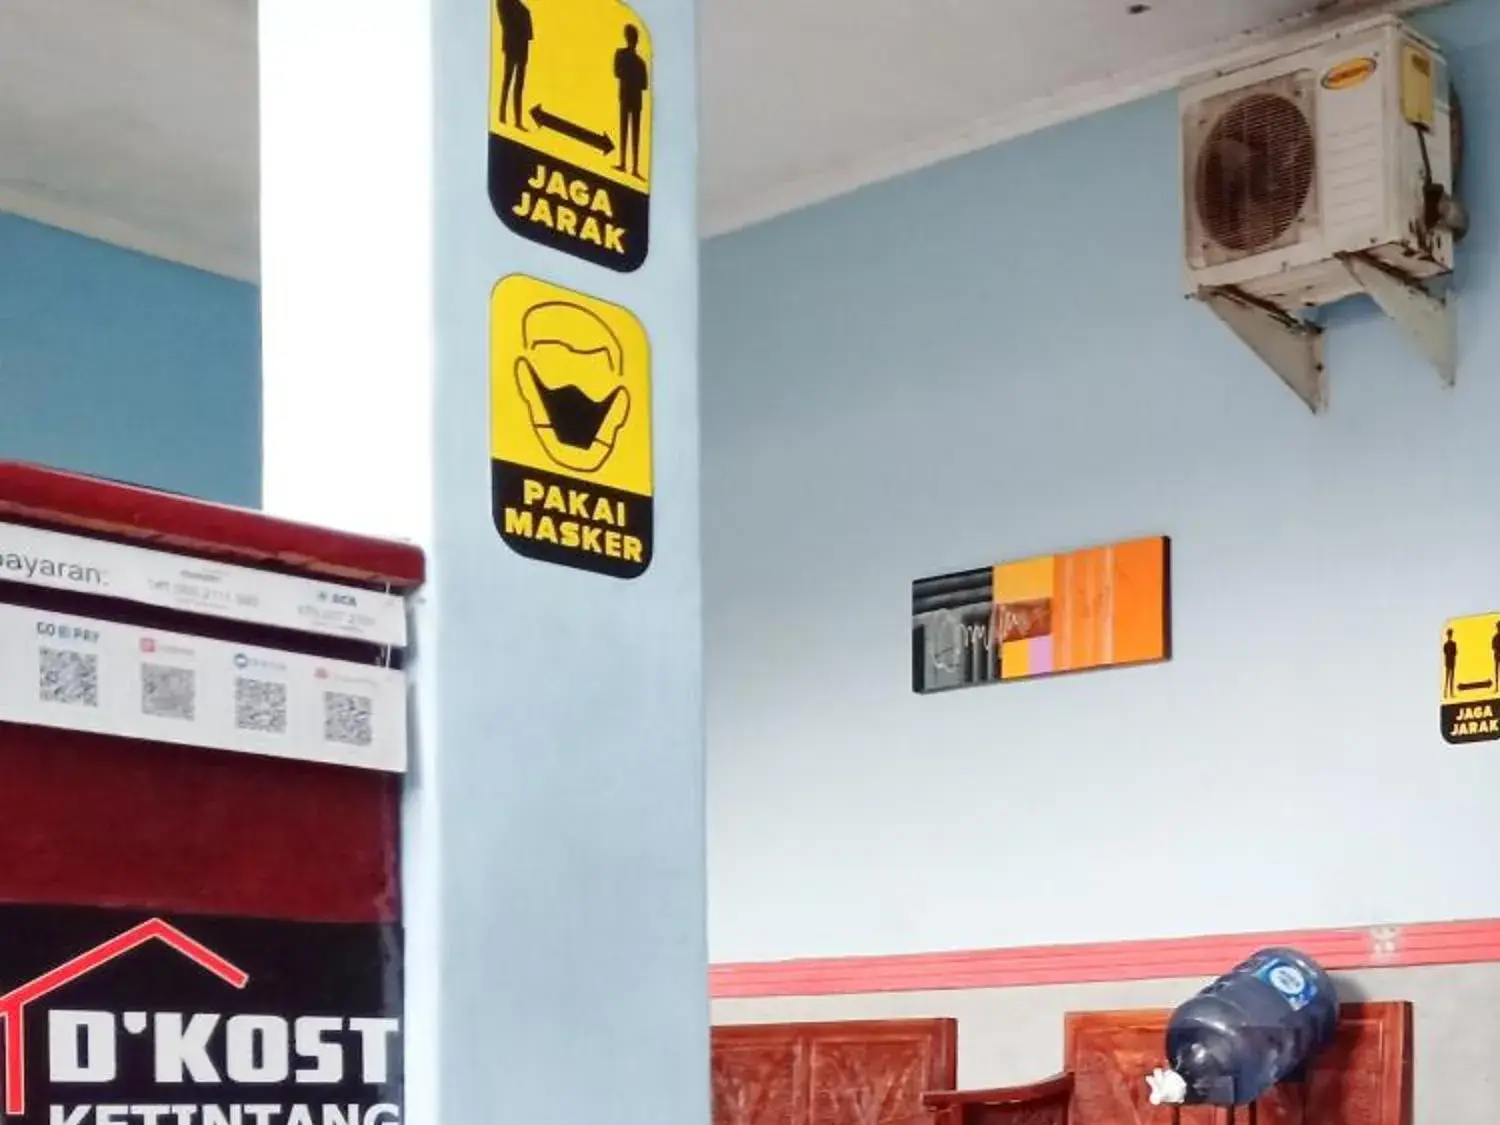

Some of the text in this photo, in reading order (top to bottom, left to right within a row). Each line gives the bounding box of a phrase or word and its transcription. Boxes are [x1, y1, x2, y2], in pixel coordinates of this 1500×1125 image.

[527, 164, 614, 217] JAGA
[513, 191, 627, 254] JARAK
[523, 478, 626, 528] PAKAI
[504, 507, 643, 562] MASKER
[0, 551, 108, 587] ayaran:
[1450, 719, 1499, 736] JARAK
[1456, 704, 1493, 720] JAGA
[48, 1009, 401, 1084] D'KOST
